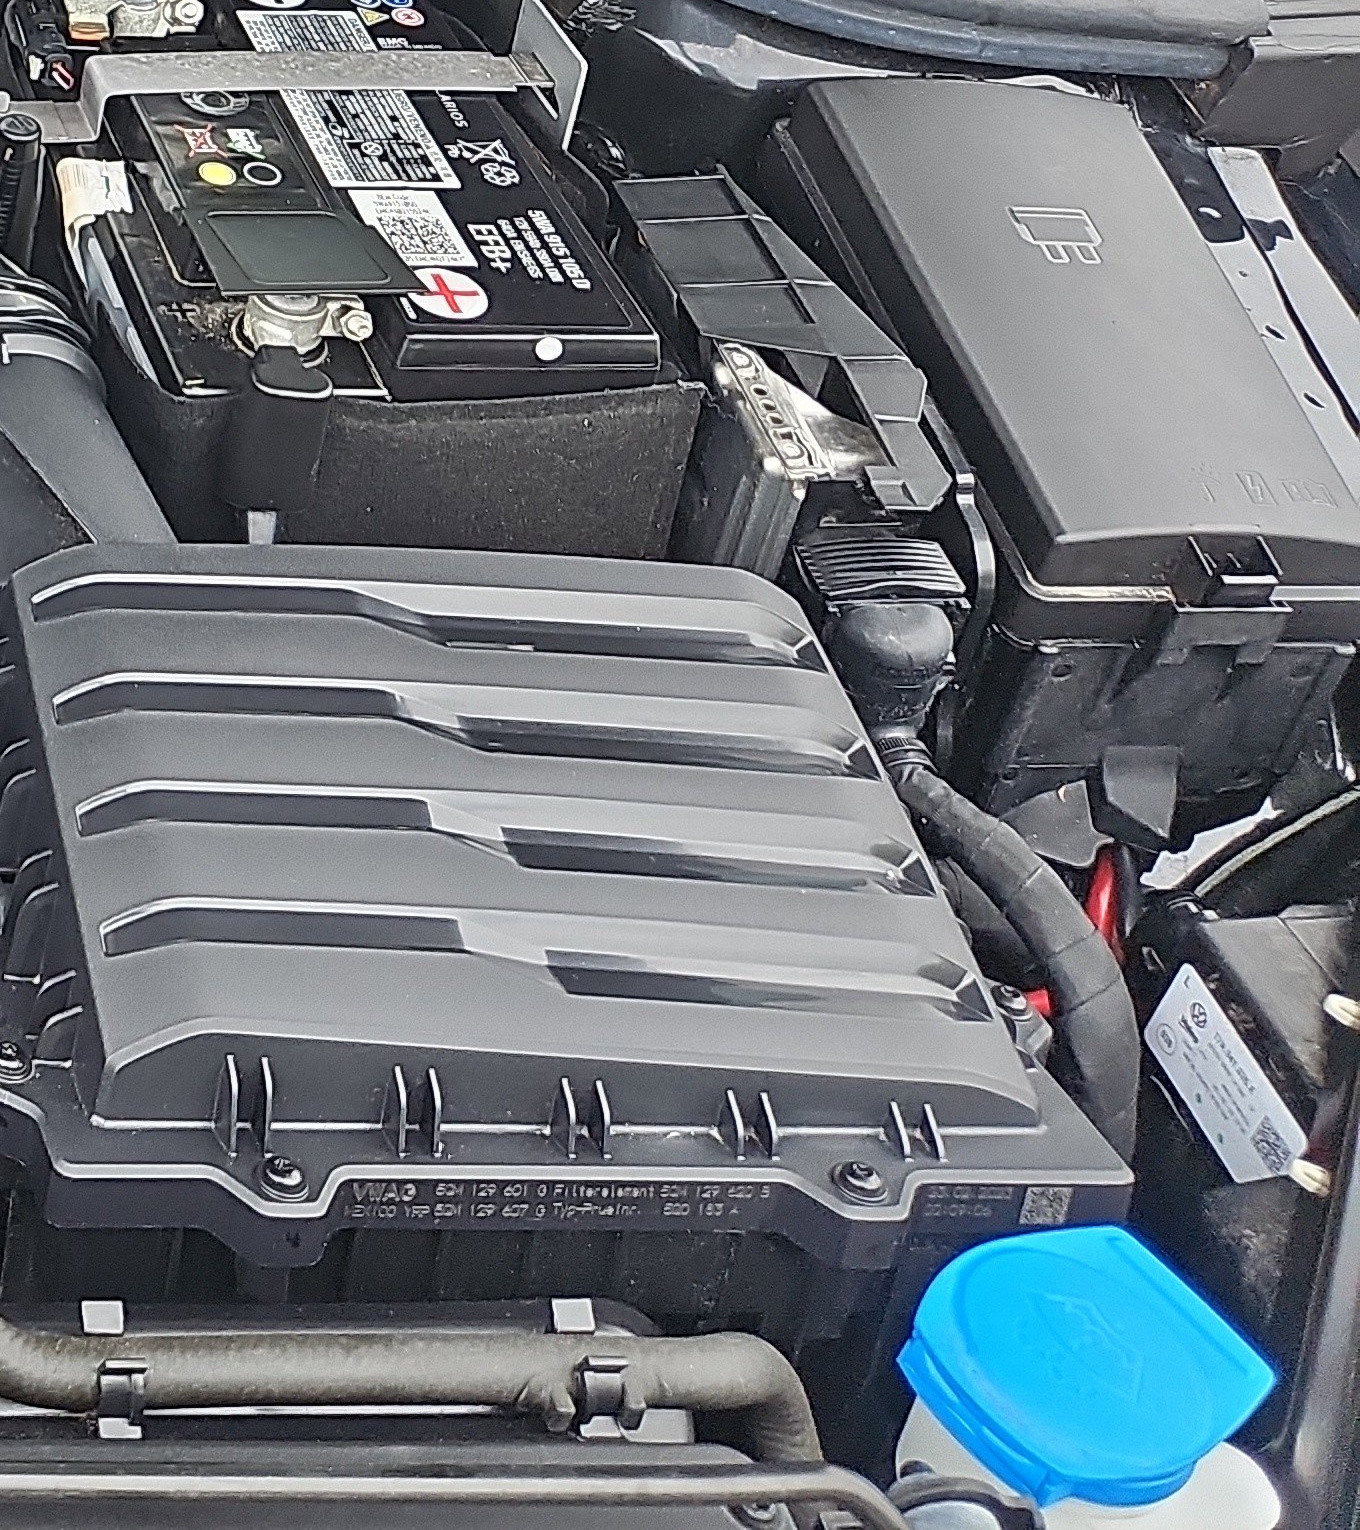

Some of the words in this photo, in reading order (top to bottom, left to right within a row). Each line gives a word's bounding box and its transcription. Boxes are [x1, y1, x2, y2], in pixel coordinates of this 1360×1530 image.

[435, 89, 469, 128] ARIOS
[466, 223, 512, 274] EFB+
[527, 209, 556, 235] 5WA
[543, 234, 571, 257] 915
[558, 258, 585, 279] 105
[473, 1183, 497, 1197] 129
[502, 1184, 527, 1197] 601
[470, 1204, 497, 1218] 129
